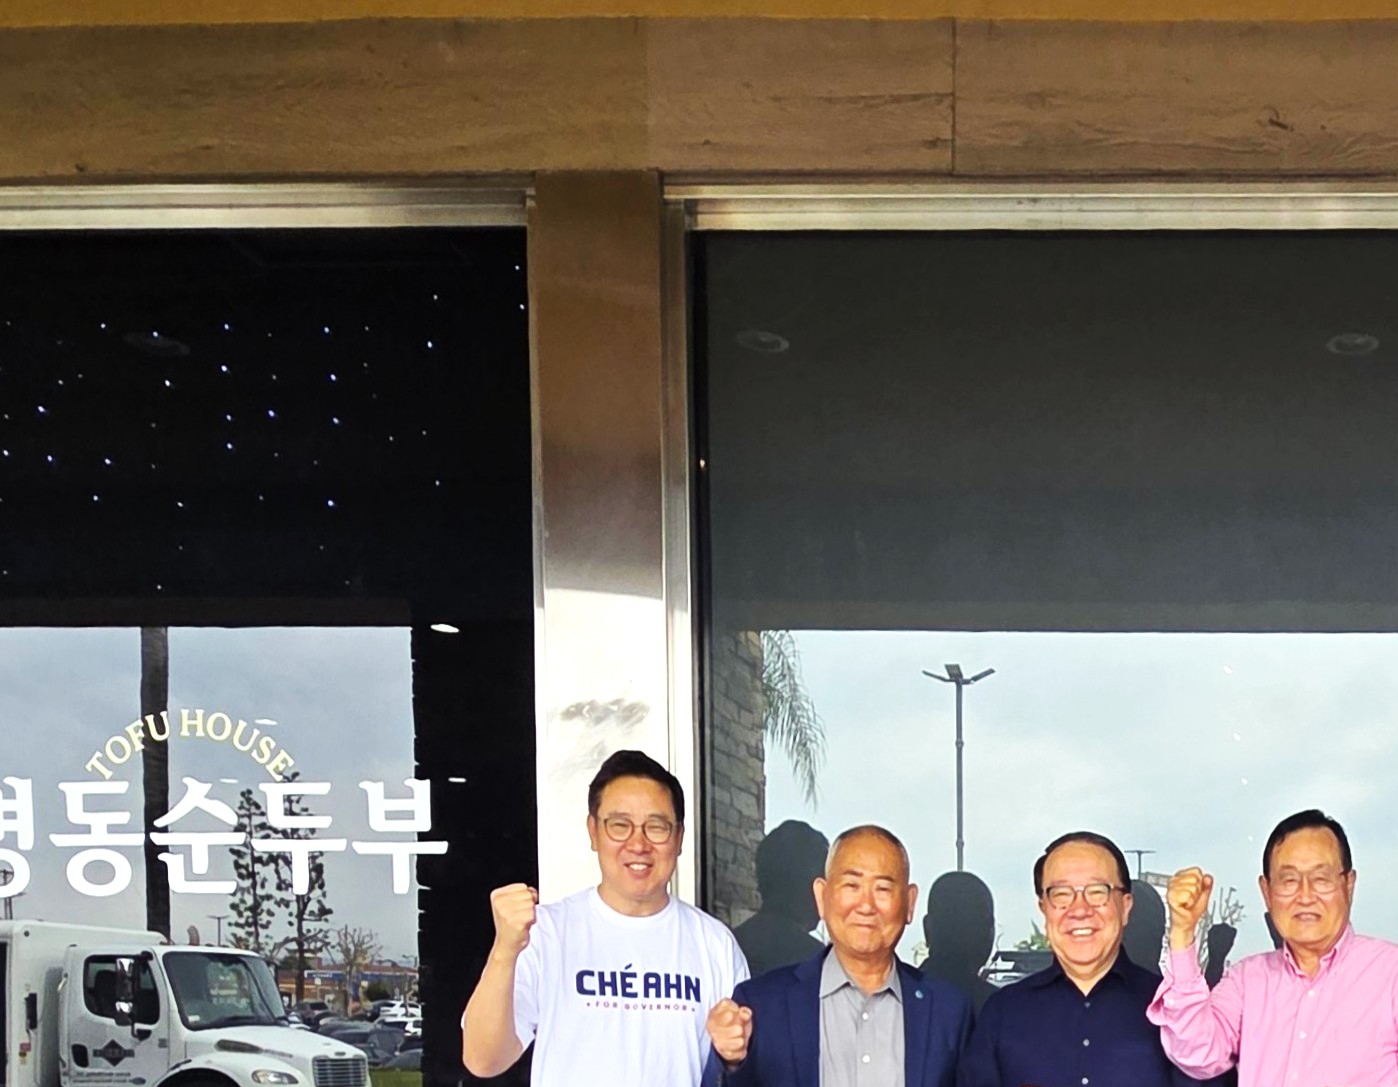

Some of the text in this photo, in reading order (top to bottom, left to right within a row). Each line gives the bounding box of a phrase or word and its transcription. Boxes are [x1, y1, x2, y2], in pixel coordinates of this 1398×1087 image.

[85, 708, 296, 781] TOFU HOUSE
[575, 963, 701, 1003] CHÉ AHN
[595, 1001, 688, 1012] FOR GOVERNOR
